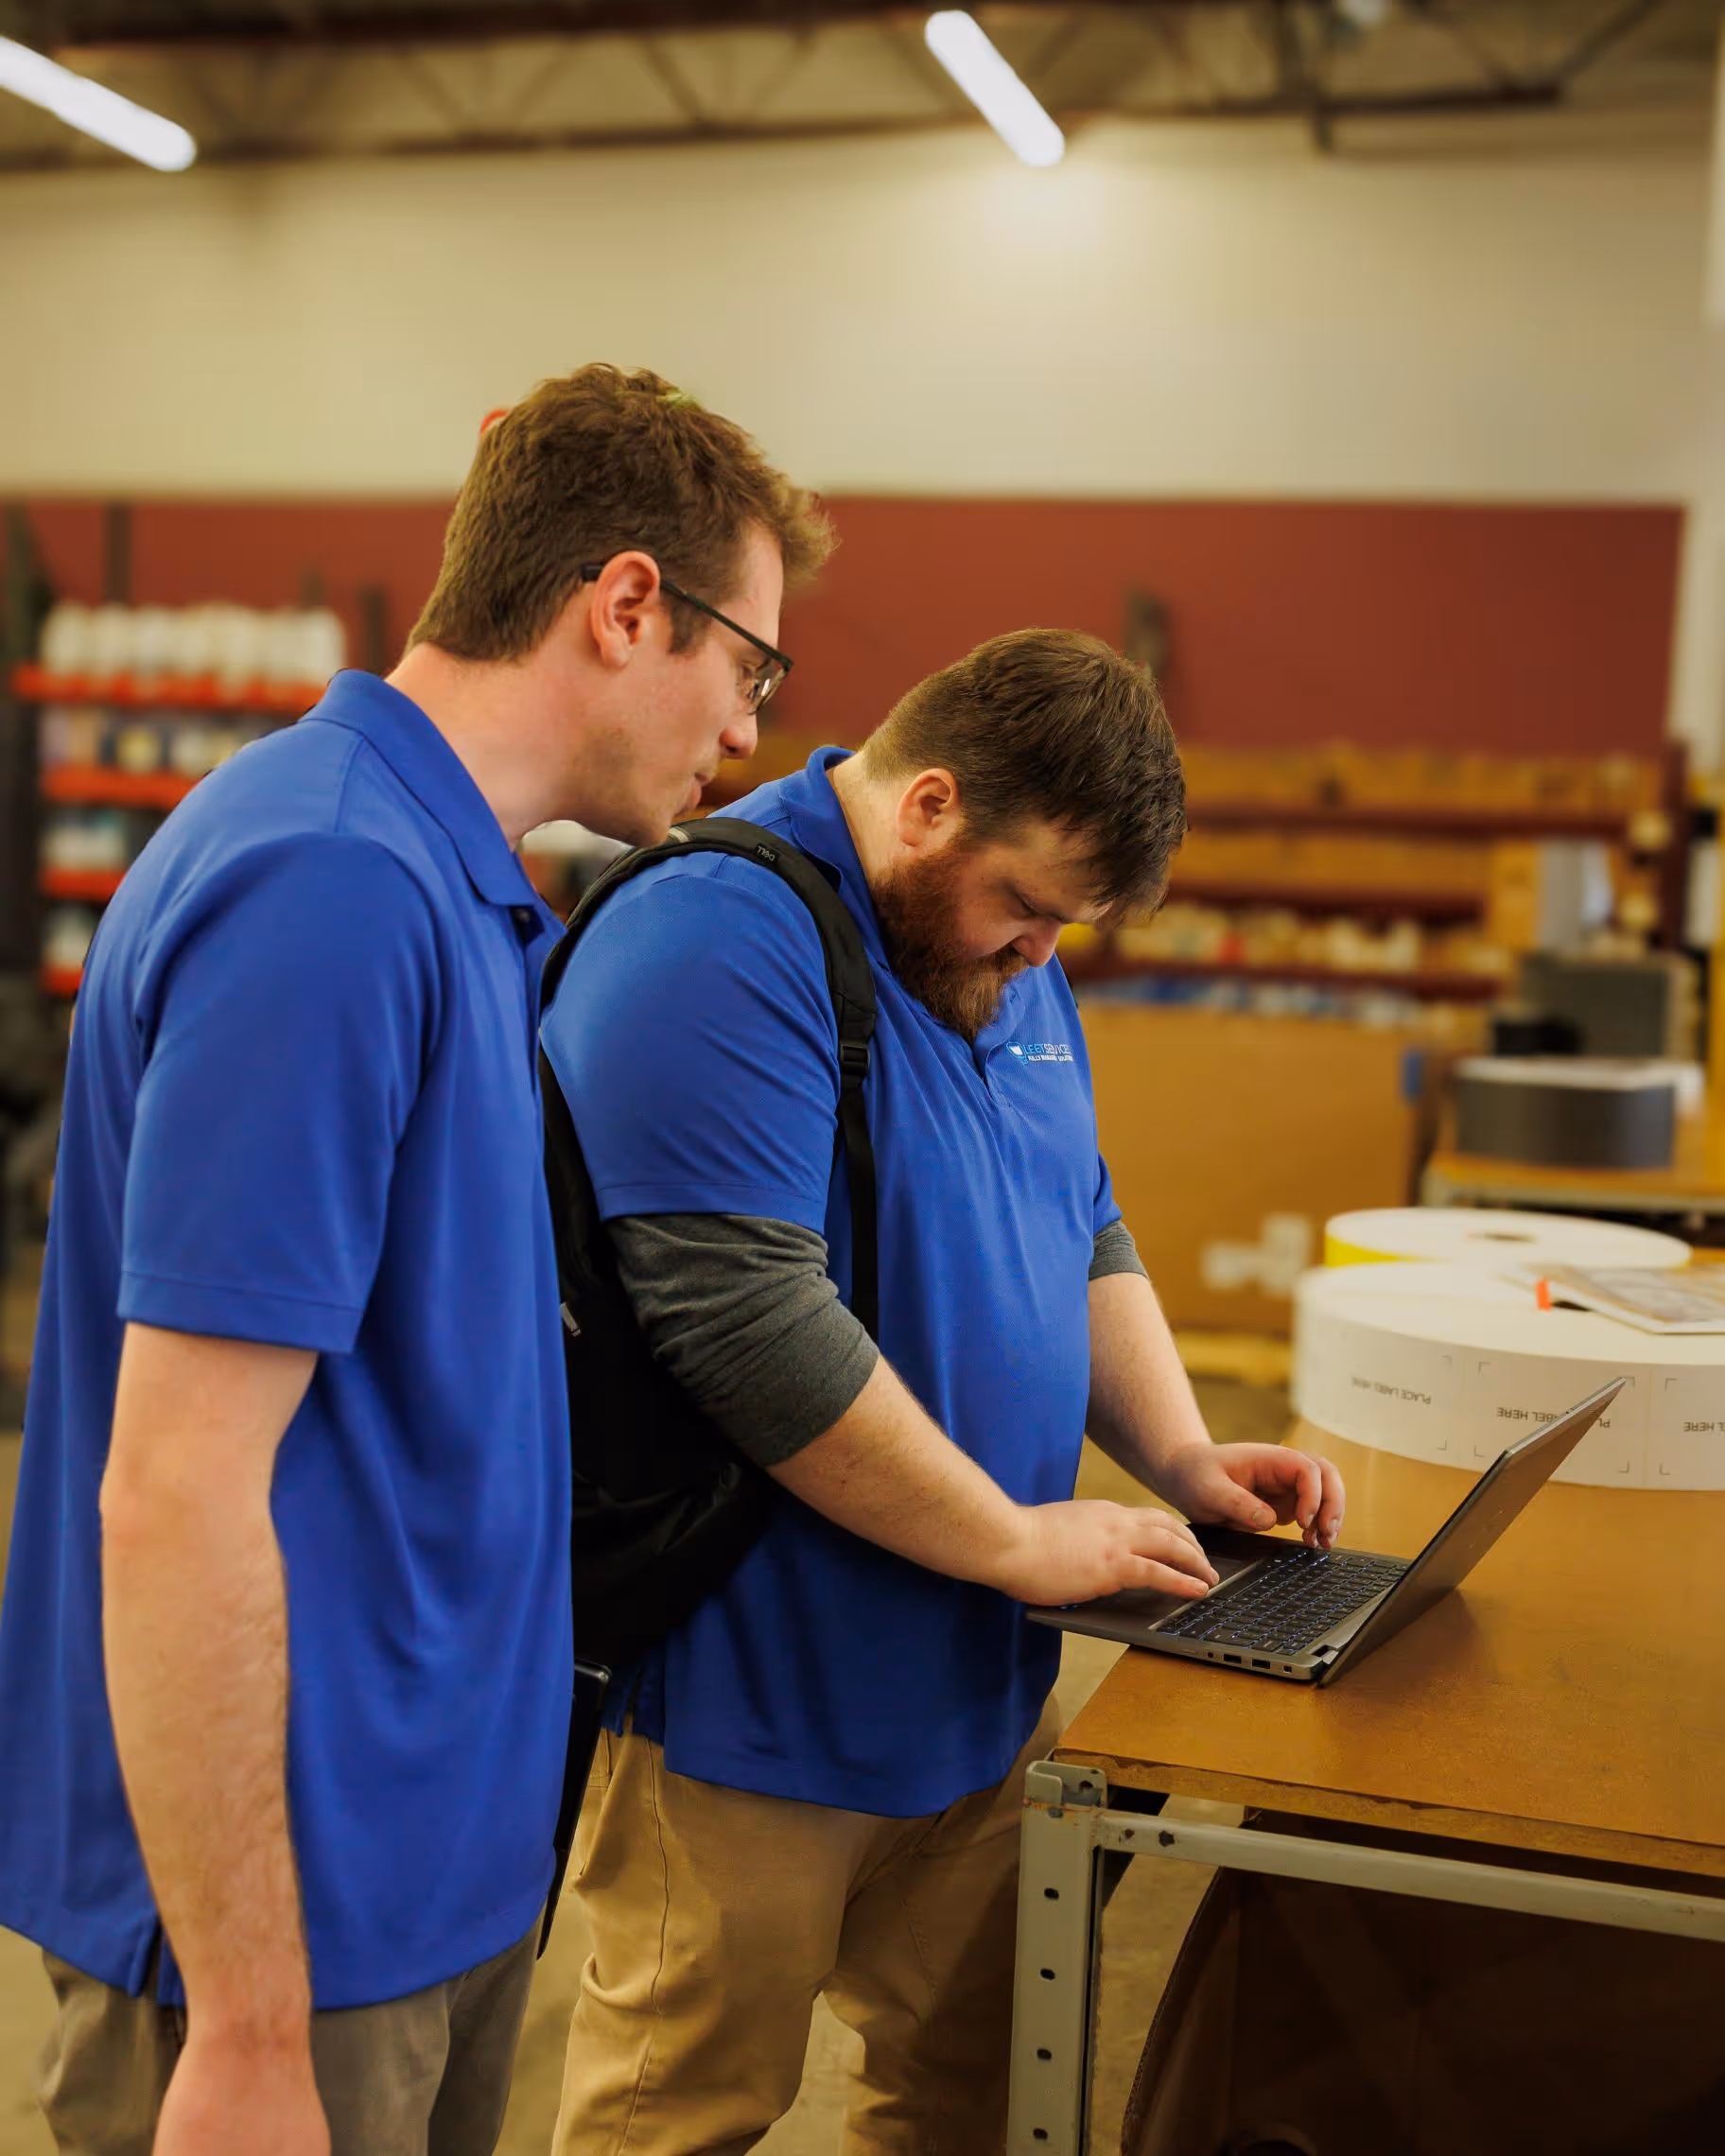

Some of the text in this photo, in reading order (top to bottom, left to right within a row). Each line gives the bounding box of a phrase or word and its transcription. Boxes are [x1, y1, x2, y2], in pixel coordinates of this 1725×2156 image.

[1402, 1389, 1431, 1405] PLACE
[1497, 1407, 1558, 1422] BEL HERE
[1683, 1422, 1715, 1432] HERE
